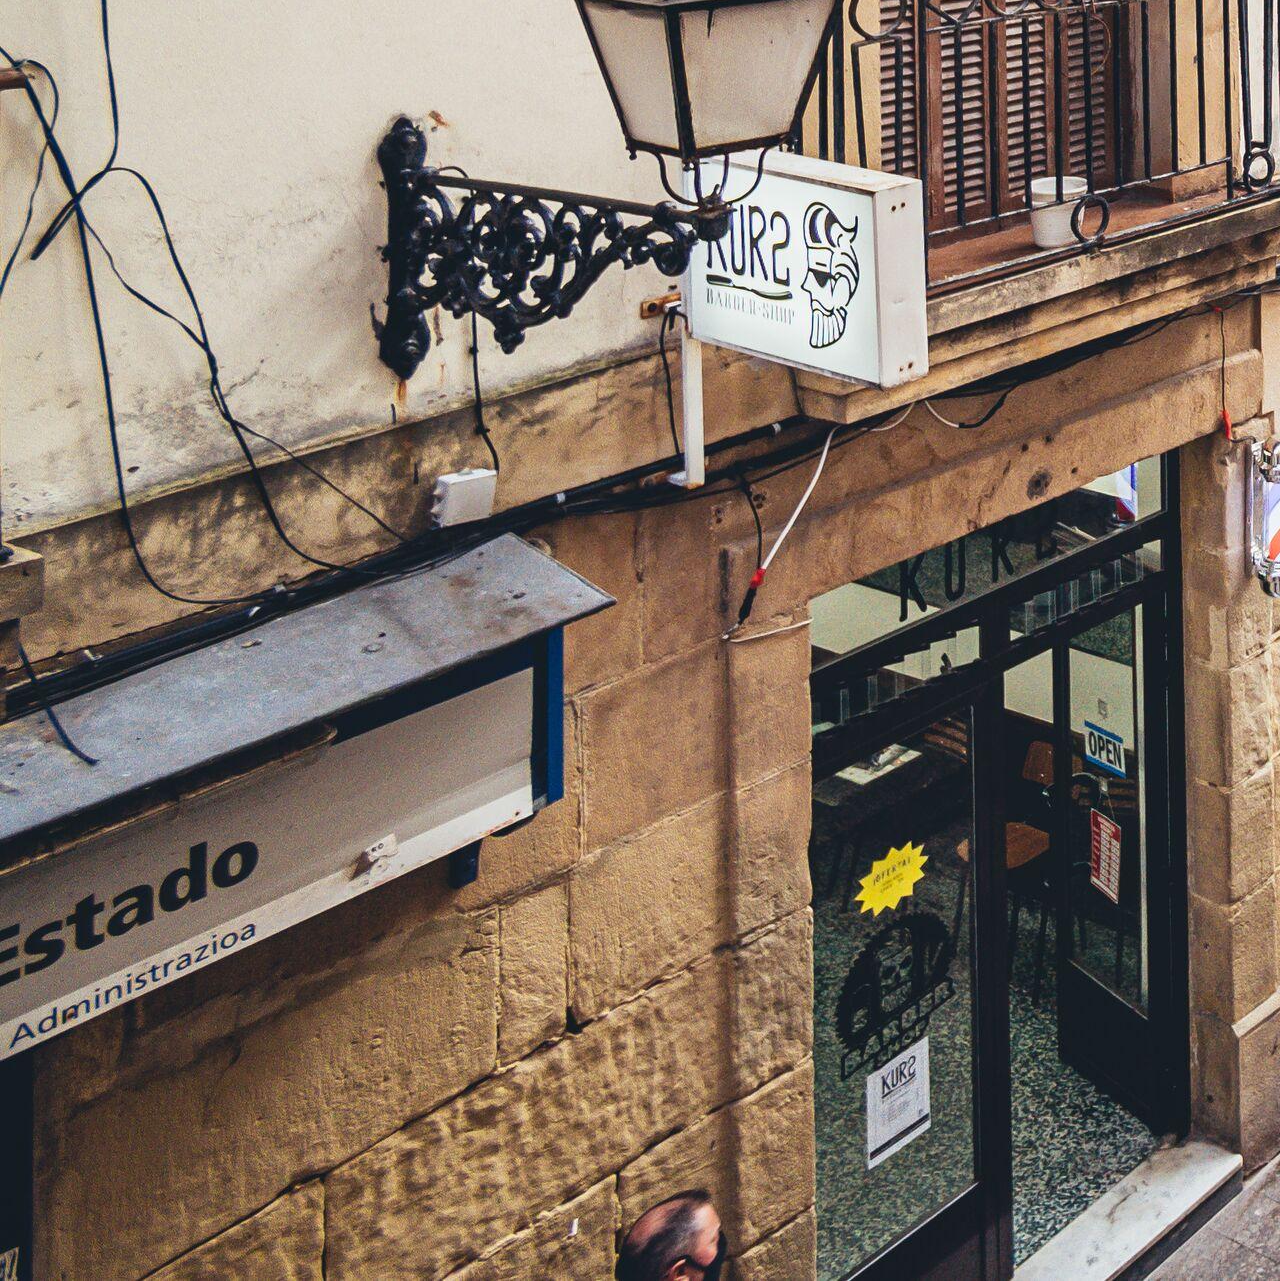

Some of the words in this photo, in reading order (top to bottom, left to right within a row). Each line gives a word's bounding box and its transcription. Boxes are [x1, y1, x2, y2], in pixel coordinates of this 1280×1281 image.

[1088, 730, 1122, 770] OPEN
[0, 840, 259, 987] Estado
[9, 922, 257, 1049] Administrazioa
